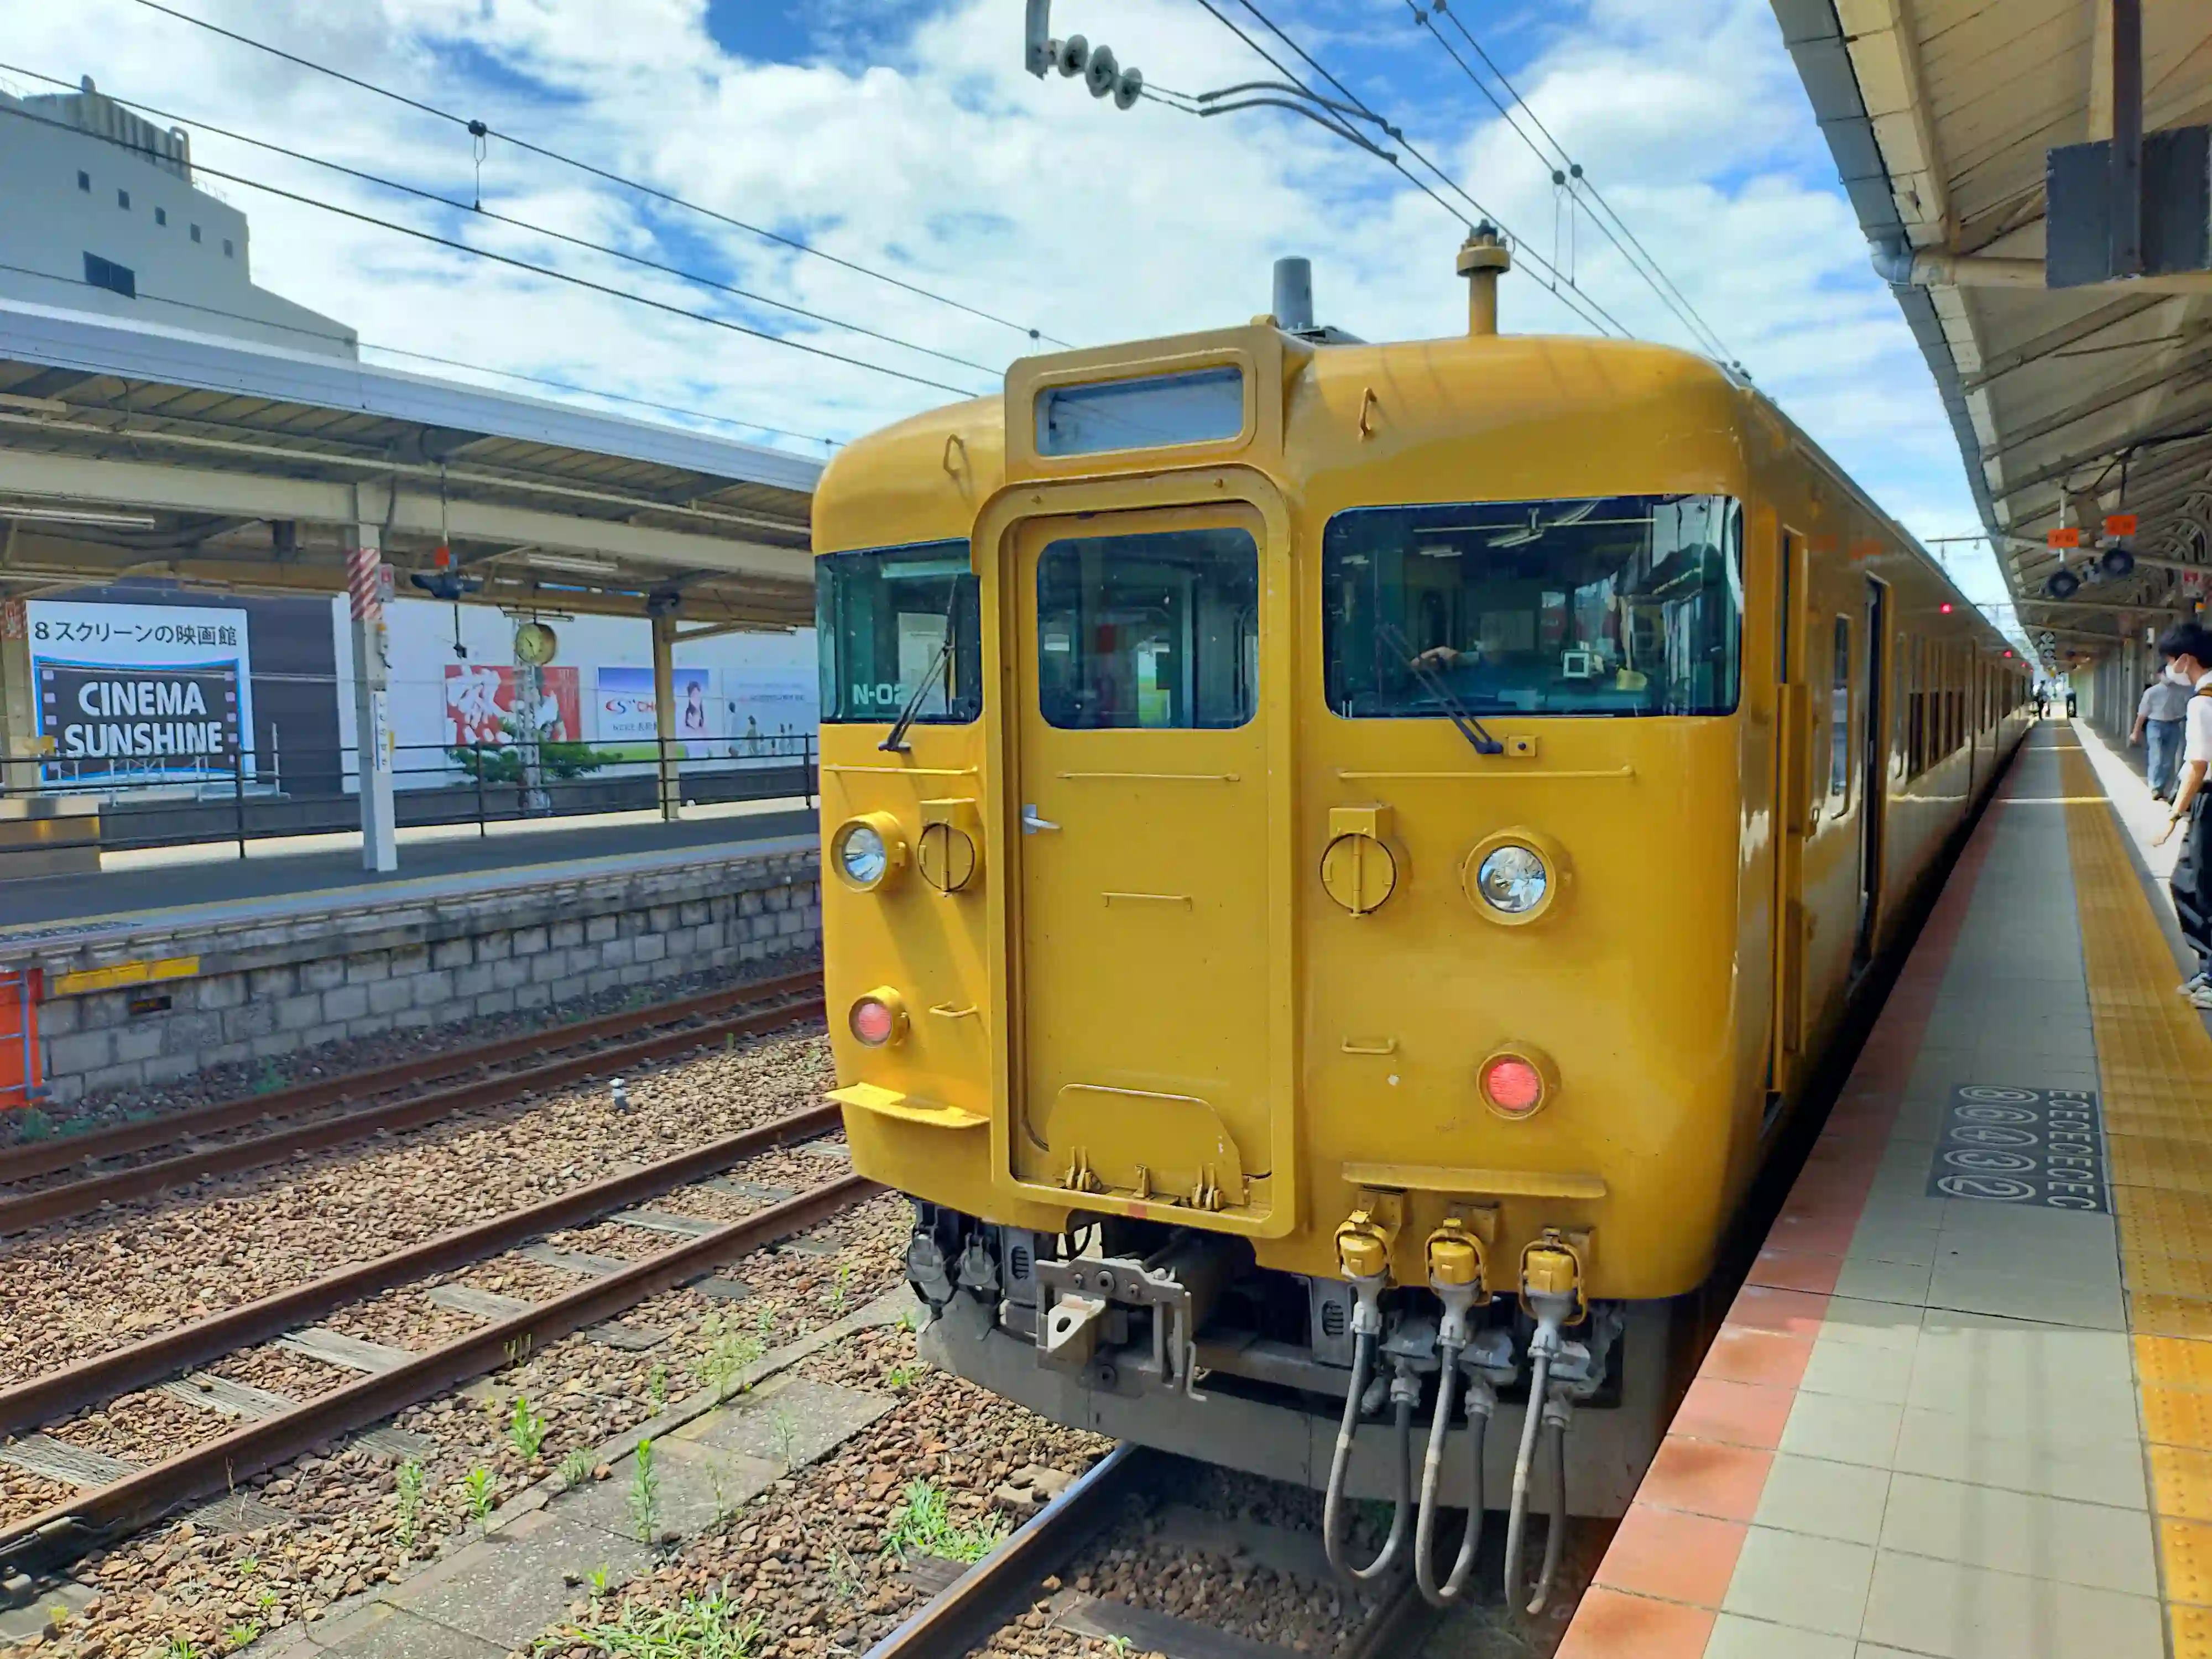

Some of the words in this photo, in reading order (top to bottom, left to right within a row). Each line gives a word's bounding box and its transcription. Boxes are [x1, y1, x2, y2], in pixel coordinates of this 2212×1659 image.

[35, 621, 237, 646] 8スクリーンの映画館
[78, 681, 206, 716] CINEMA
[65, 722, 223, 758] SUNSHINE
